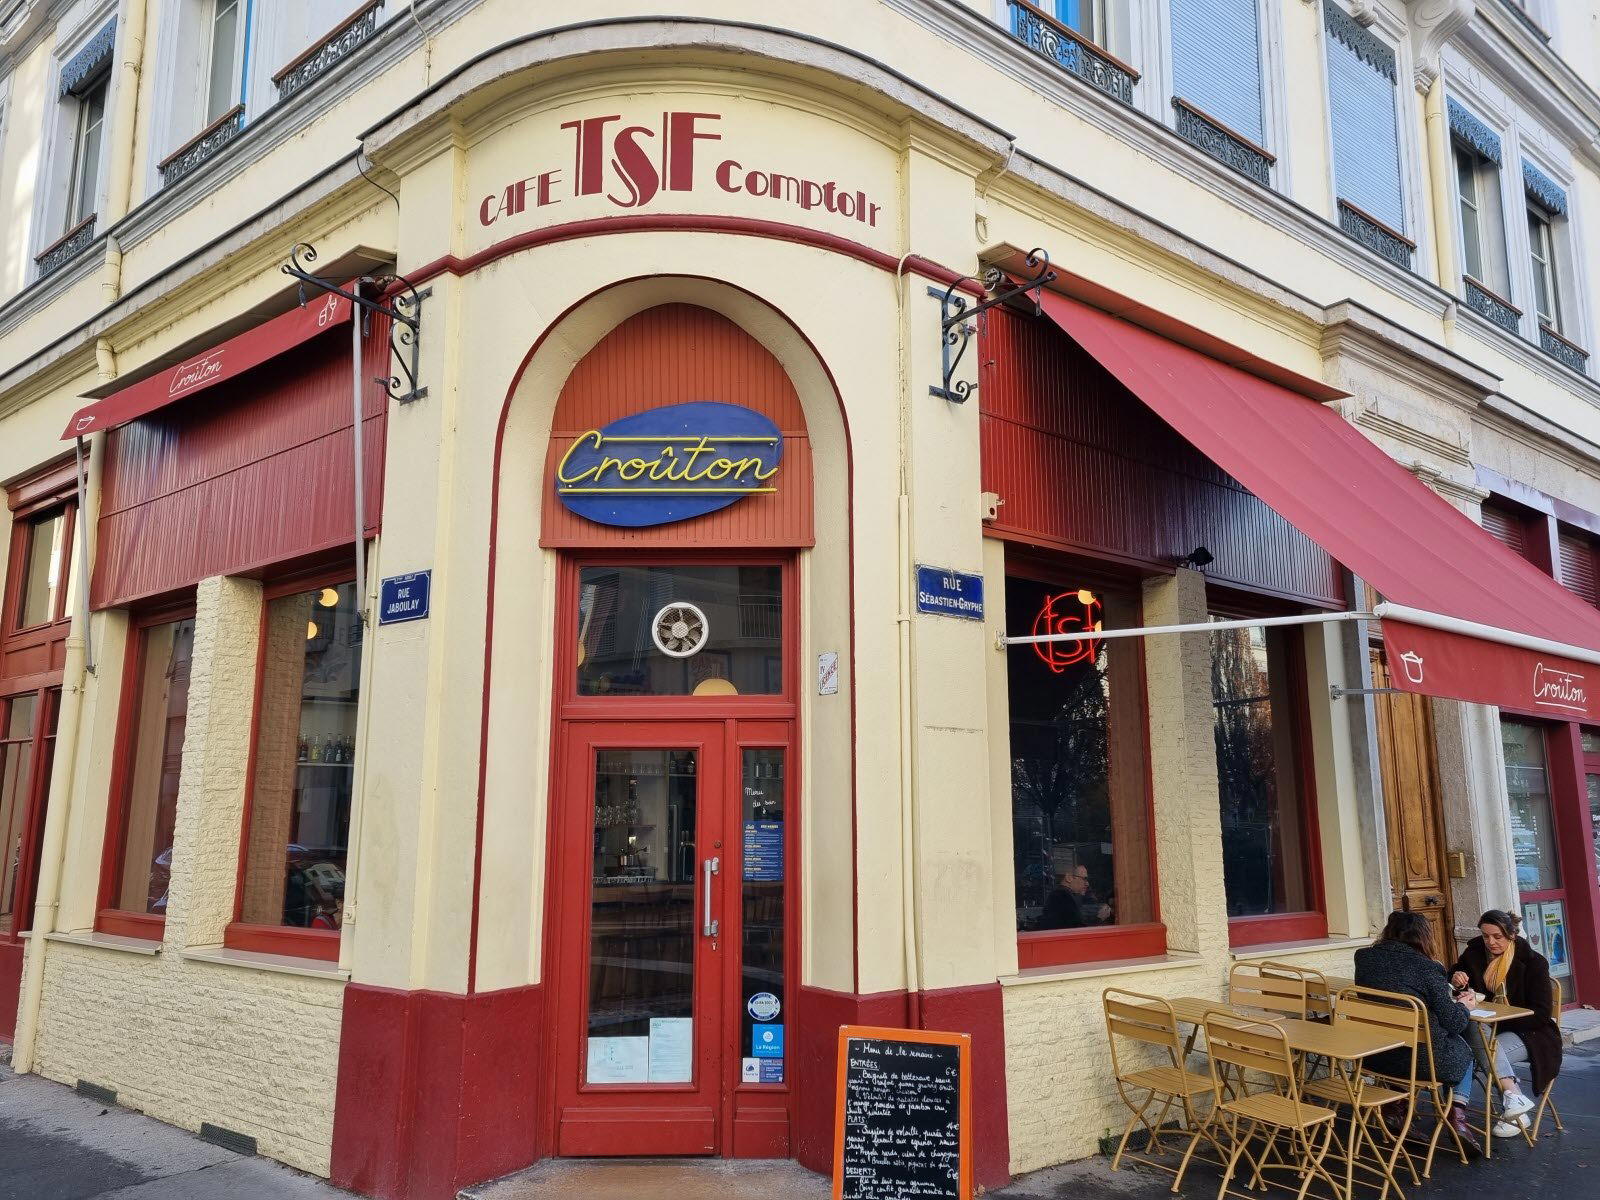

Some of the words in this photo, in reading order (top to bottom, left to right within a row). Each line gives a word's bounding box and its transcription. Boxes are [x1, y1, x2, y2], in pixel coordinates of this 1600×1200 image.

[480, 169, 562, 226] CAFE
[560, 112, 722, 208] TSF
[558, 430, 779, 483] Croûton
[943, 576, 962, 592] RUE
[398, 588, 410, 600] RUE
[386, 598, 420, 614] JABOULAY
[744, 786, 764, 796] Menu
[863, 1042, 881, 1055] Menu
[885, 1047, 893, 1056] de
